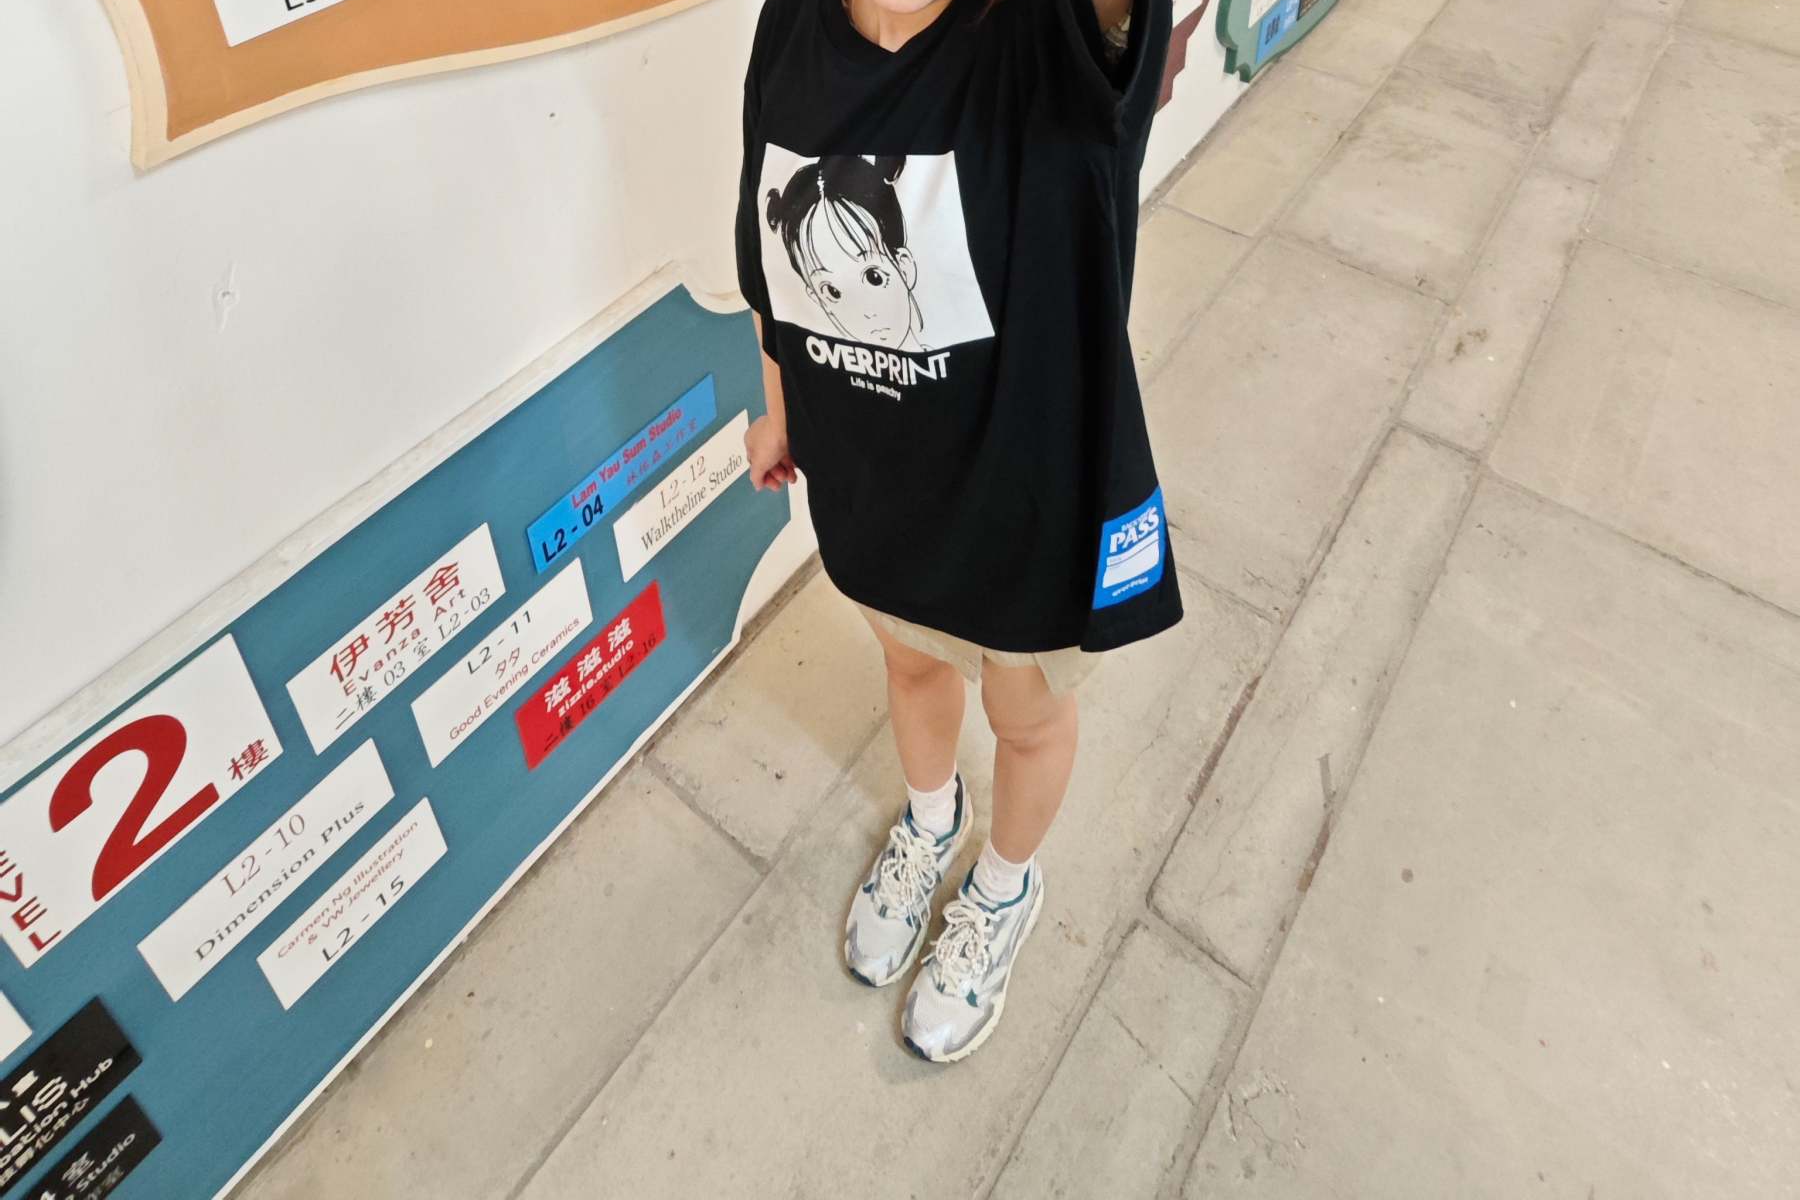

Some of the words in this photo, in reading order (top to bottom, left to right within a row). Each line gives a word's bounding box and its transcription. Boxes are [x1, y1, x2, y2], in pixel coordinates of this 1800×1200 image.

[805, 335, 950, 385] OVERPRINT
[851, 376, 866, 389] Life
[866, 380, 875, 391] is
[572, 481, 598, 509] Lam
[599, 459, 621, 483] Yau
[622, 438, 647, 465] Sum
[648, 408, 683, 441] Studio
[640, 485, 707, 551] Walktheline
[708, 453, 743, 488] Studio
[542, 528, 567, 563] L2
[582, 495, 604, 528] 04
[1109, 506, 1159, 553] PASS
[343, 628, 422, 696] Evanza
[433, 588, 467, 623] Art
[383, 661, 407, 688] 03
[449, 705, 482, 741] Good
[484, 663, 529, 711] Evening
[531, 616, 581, 664] Ceramics
[49, 714, 220, 902] 2
[227, 738, 270, 782] 樓
[0, 850, 61, 951] VEL
[194, 846, 317, 961] Dimension
[321, 799, 365, 844] Plus
[277, 907, 331, 960] Carmen
[331, 880, 352, 909] Ng
[351, 819, 419, 890] Illustration
[306, 932, 319, 945] &
[346, 848, 405, 910] Jewellery
[70, 1058, 113, 1098] Hub
[76, 1133, 136, 1192] Studio
